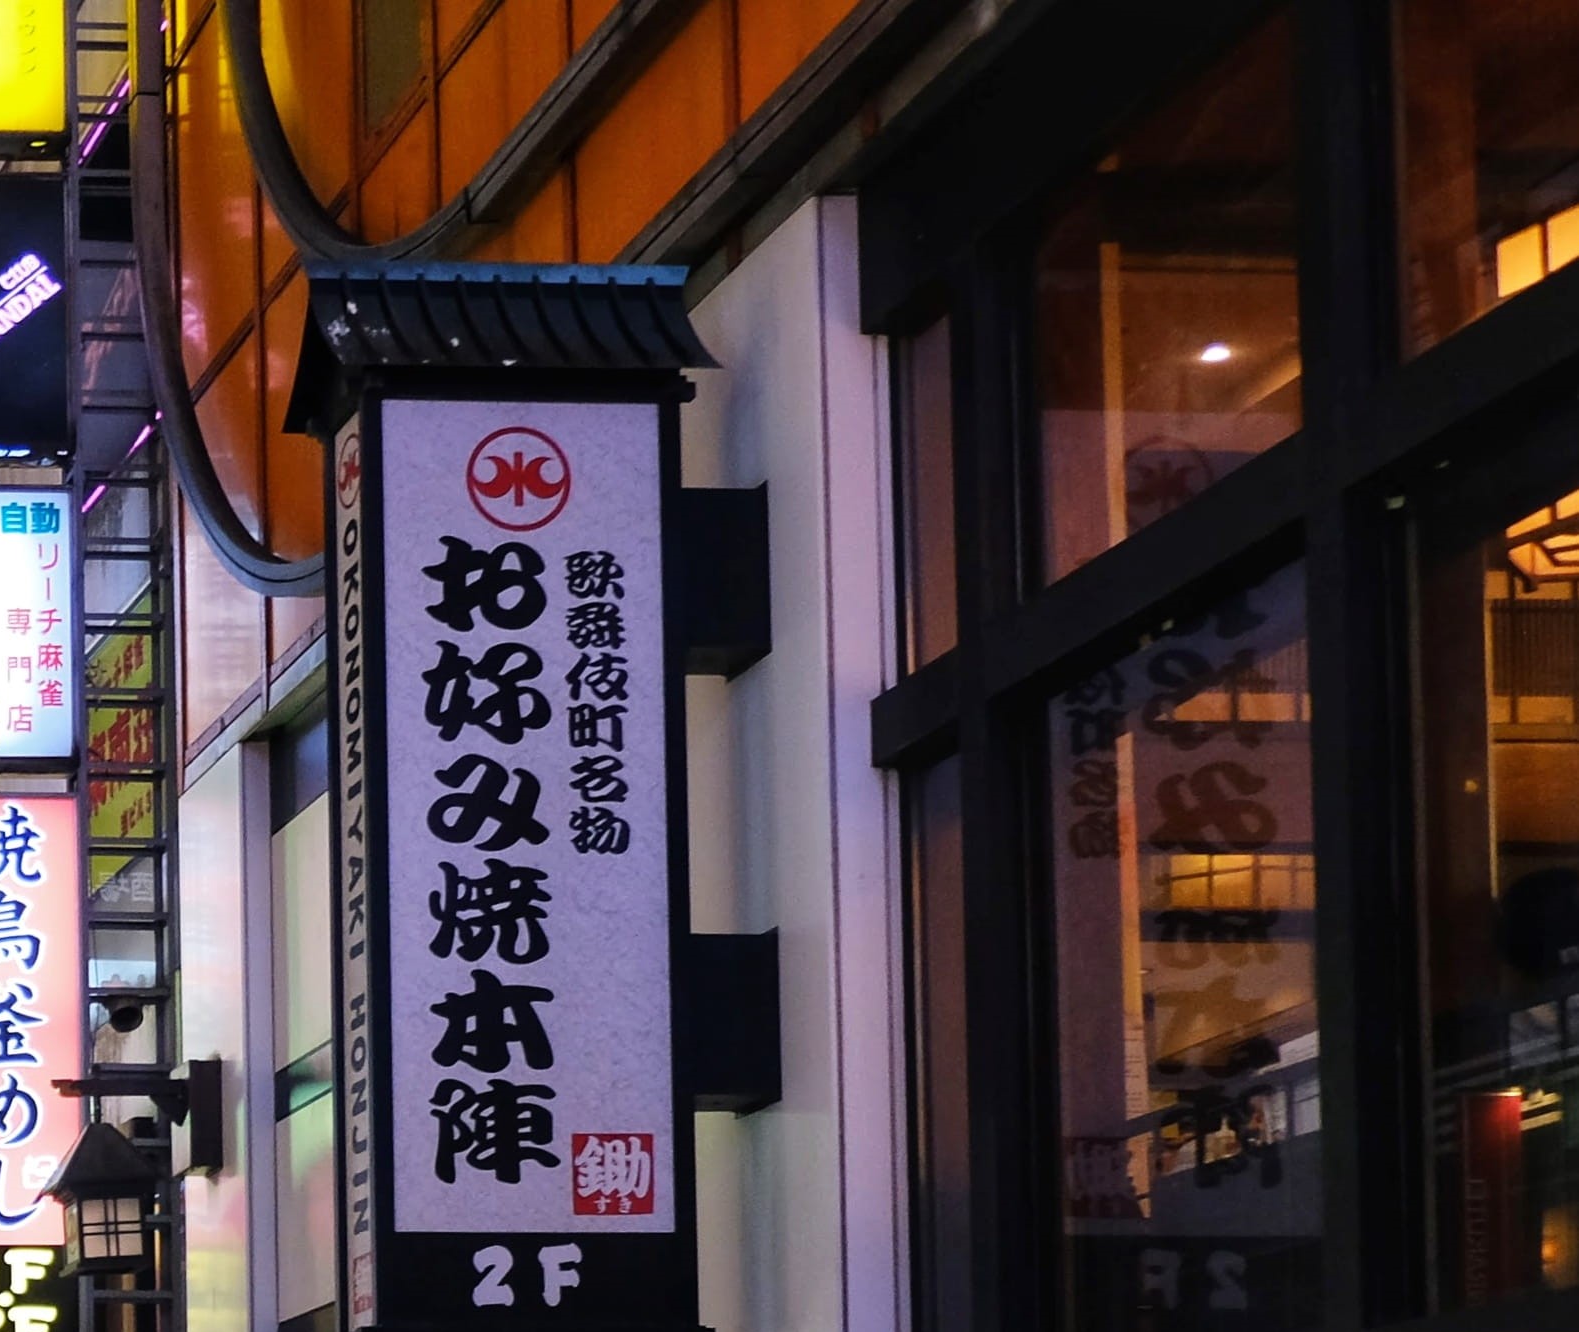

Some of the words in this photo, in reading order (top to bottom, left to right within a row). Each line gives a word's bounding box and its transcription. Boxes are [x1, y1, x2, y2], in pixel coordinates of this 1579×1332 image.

[6, 607, 33, 734] 専門店
[36, 543, 65, 708] リーチ麻雀
[564, 549, 631, 856] 歌舞伎町名物
[341, 516, 368, 961] OKONOMIYAKI
[421, 534, 562, 1186] お好み焼本陣
[349, 995, 371, 1237] HONJIN
[573, 1134, 653, 1200] 鋤
[471, 1242, 583, 1308] 2F
[593, 1197, 634, 1216] すき
